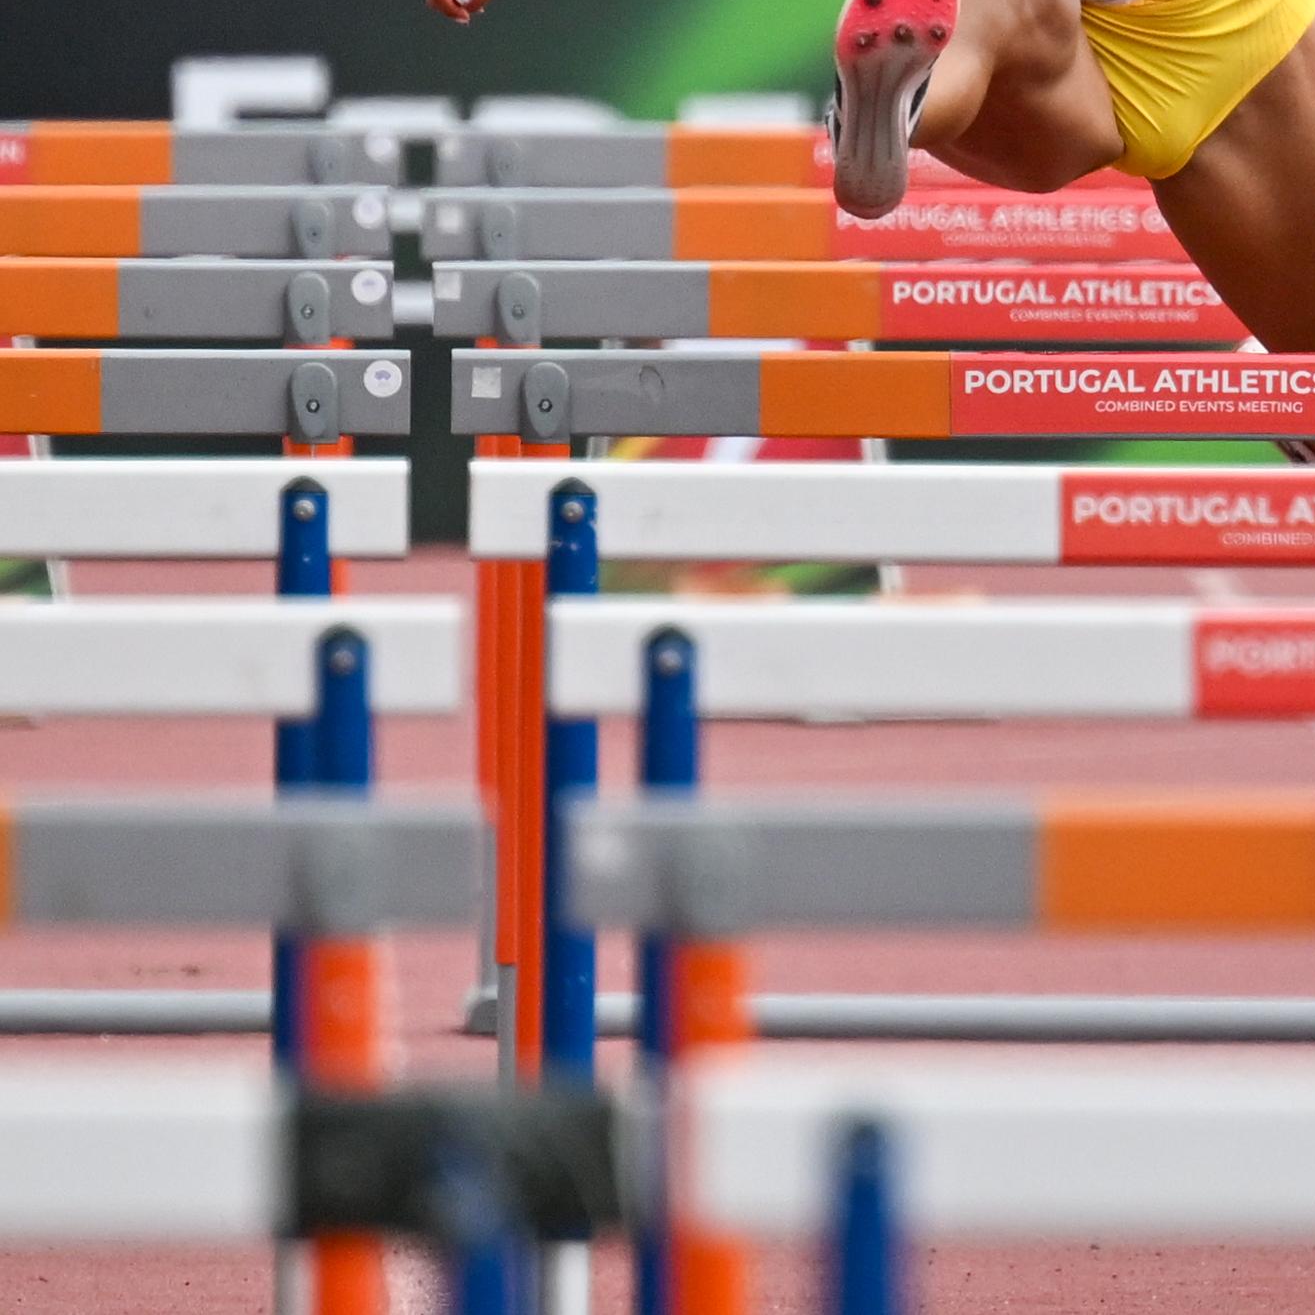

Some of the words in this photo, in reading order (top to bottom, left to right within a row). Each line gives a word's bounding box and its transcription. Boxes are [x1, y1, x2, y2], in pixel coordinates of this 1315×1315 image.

[893, 280, 1055, 305] PORTUGAL
[1062, 280, 1222, 306] ATHLETICS
[964, 368, 1146, 395] PORTUGAL
[1095, 400, 1176, 413] COMBINED
[1179, 400, 1235, 413] EVENTS
[1238, 400, 1304, 414] MEETING
[1073, 495, 1277, 526] PORTUGAL
[1222, 532, 1314, 546] COMBINED
